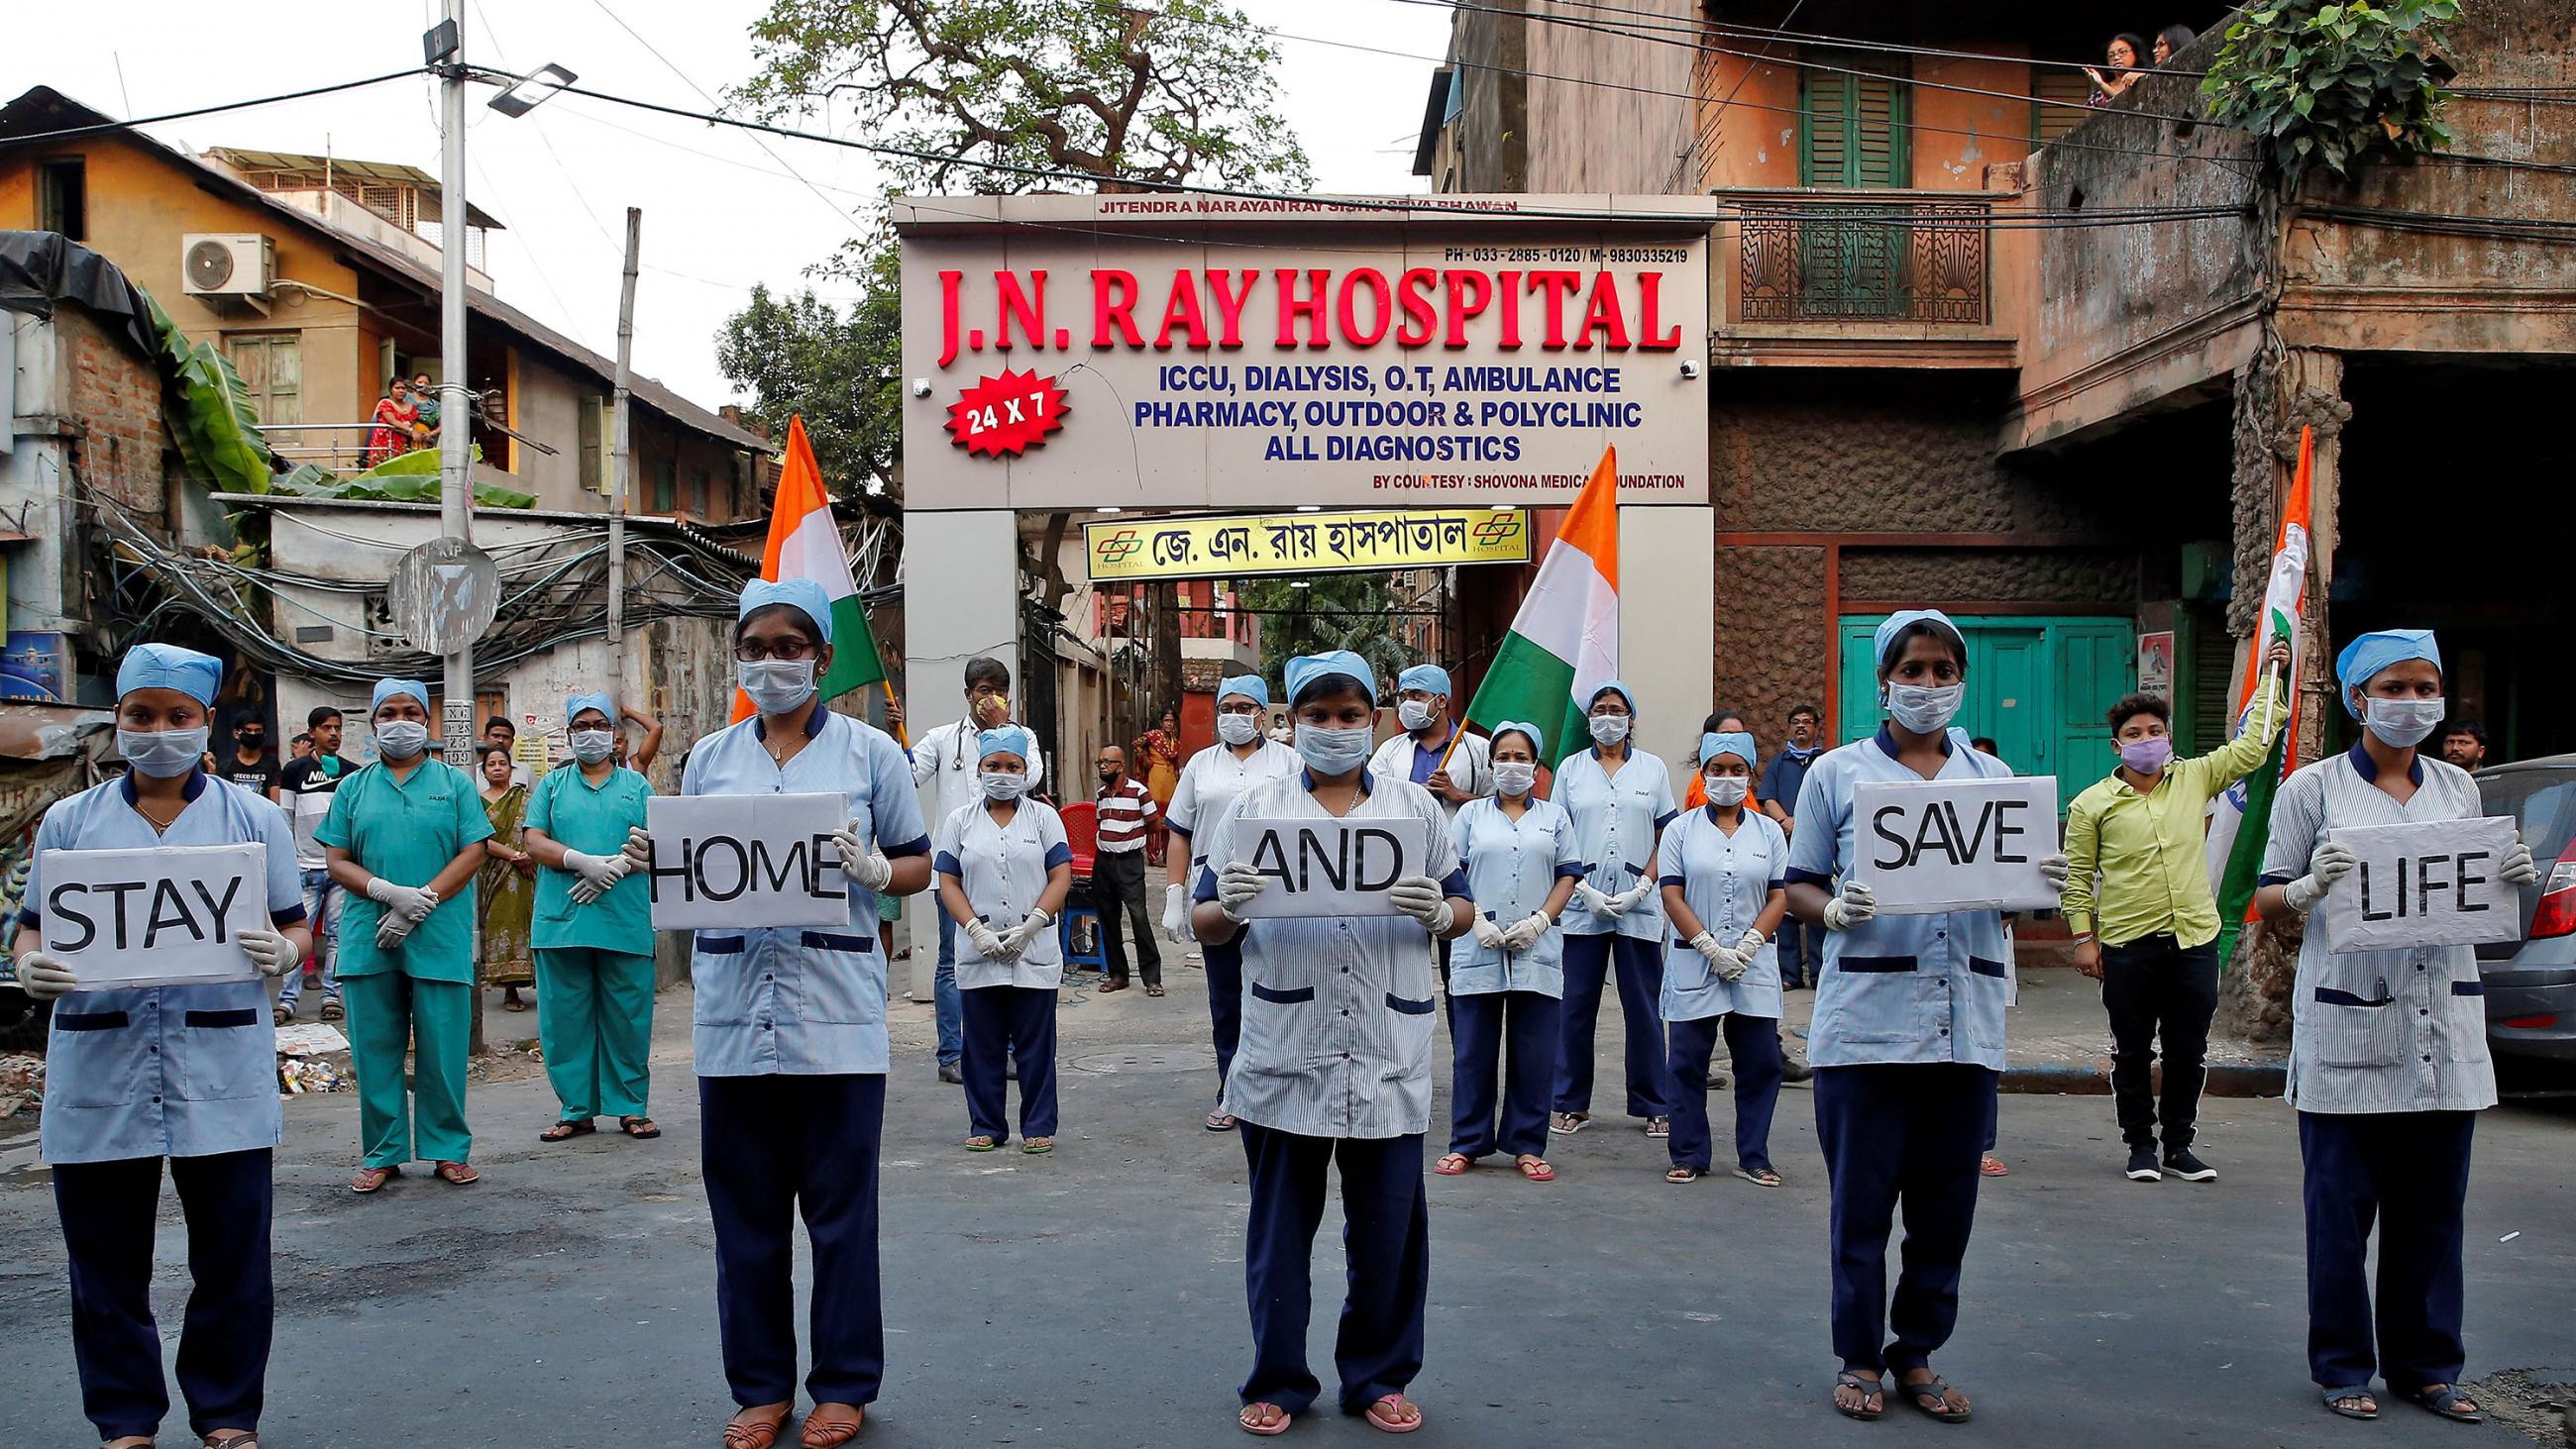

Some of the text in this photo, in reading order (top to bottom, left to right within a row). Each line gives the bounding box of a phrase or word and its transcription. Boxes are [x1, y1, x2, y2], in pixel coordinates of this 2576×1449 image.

[1099, 201, 1193, 214] JITENDRA
[1197, 200, 1285, 213] NARAYAN
[1289, 201, 1324, 212] RAY
[1446, 249, 1463, 262] PH
[1473, 249, 1498, 262] 033
[1508, 249, 1541, 262] 2885
[1550, 249, 1580, 262] 0120
[1610, 249, 1688, 263] 9830335219
[1091, 268, 1259, 349] RAY
[1275, 267, 1681, 351] HOSPITAL
[1159, 364, 1620, 395] ICCU, DIALYSIS, O.T, AMBULANCE
[967, 391, 1045, 436] 24 X 7
[1134, 401, 1642, 431] PHARMACY, OUTDOOR & POLYCLINIC
[1264, 436, 1521, 462] ALL DIAGNOSTICS
[1373, 475, 1391, 488] BY
[1473, 474, 1538, 488] SHOVONA
[1541, 474, 1588, 488] MEDICA
[1615, 475, 1685, 489] UNDATION
[1153, 513, 1468, 567] জে. এন. রায় হাসপাতাল
[1473, 544, 1522, 553] HOSPITAL
[1097, 561, 1144, 569] HOSPITAL
[307, 770, 331, 782] NIK
[1873, 800, 2029, 871] SAVE
[647, 834, 846, 903] HOME
[1250, 828, 1404, 894] AND
[2360, 852, 2490, 922] LIFE
[49, 876, 242, 953] STAY
